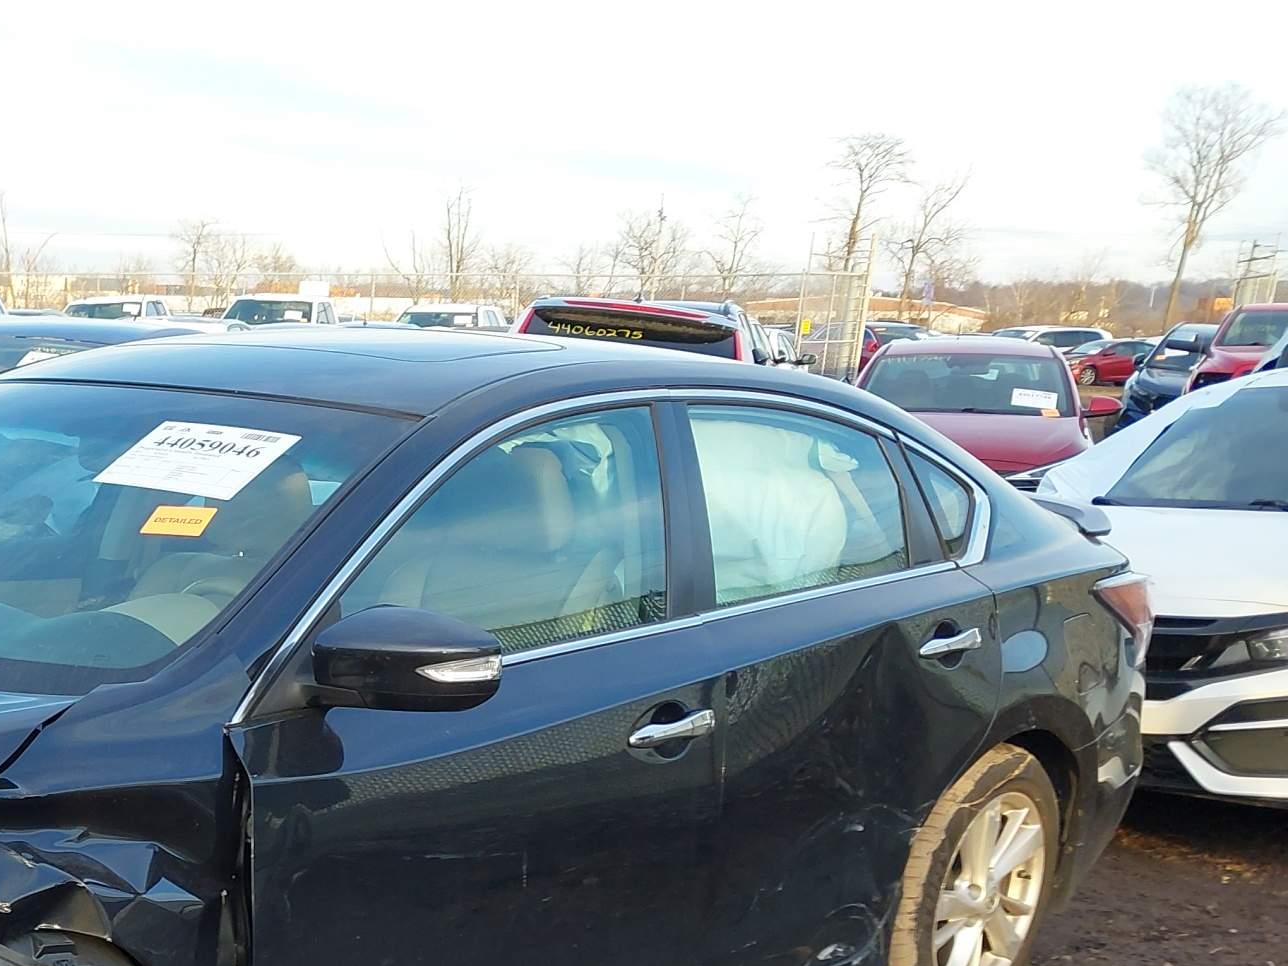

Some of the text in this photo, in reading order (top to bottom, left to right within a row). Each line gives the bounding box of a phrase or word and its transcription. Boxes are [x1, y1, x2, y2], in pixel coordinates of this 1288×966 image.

[548, 321, 643, 339] 44060275
[153, 435, 268, 459] 44059046
[153, 516, 203, 526] DETAILED
